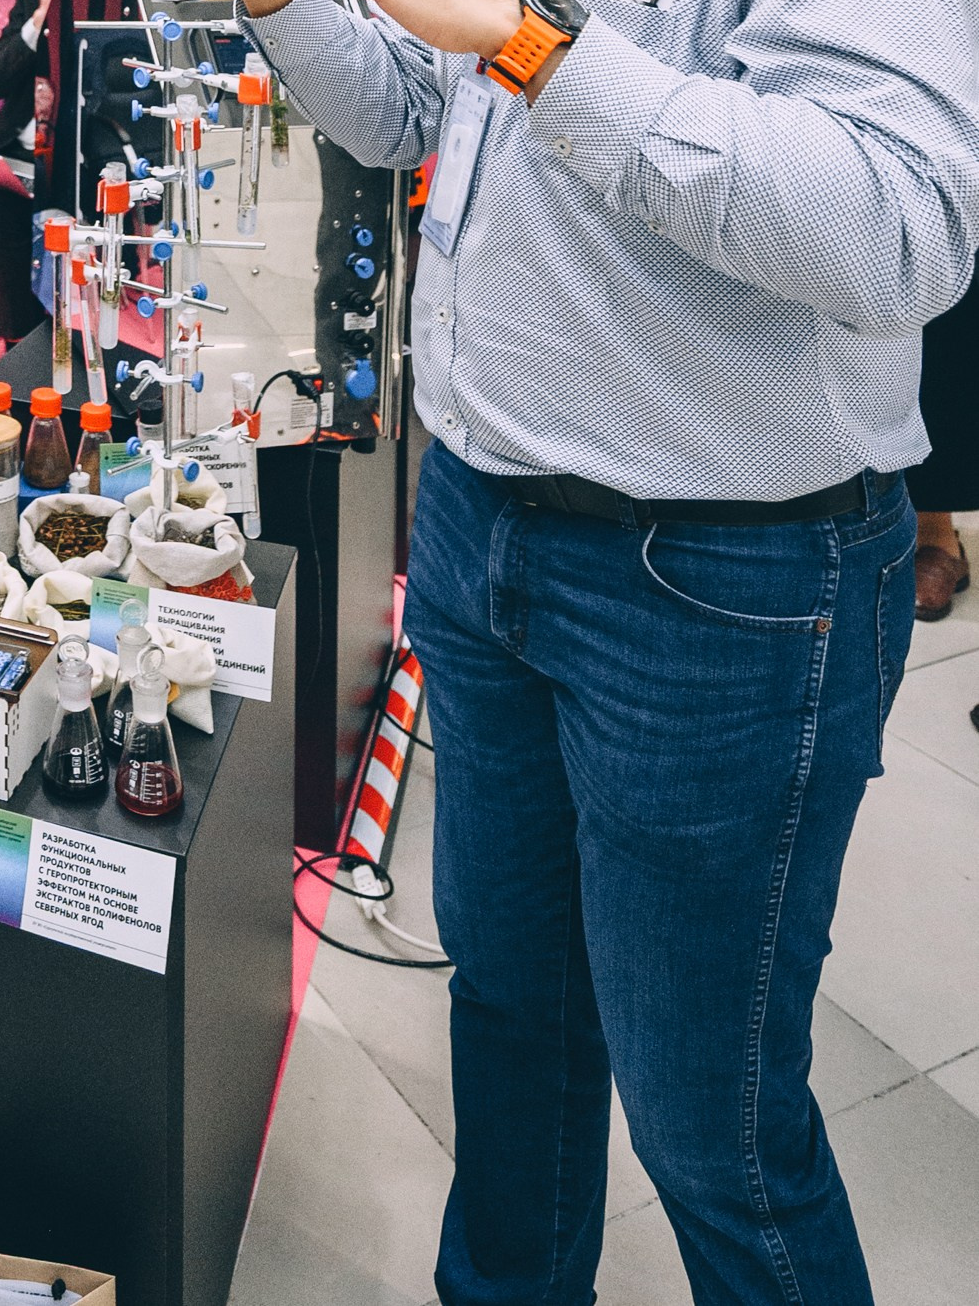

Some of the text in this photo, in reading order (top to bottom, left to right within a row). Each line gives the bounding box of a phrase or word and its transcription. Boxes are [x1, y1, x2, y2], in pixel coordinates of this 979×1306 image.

[157, 617, 226, 635] ВЫРАЩИВАНИЯ
[158, 605, 215, 622] ТЕХНОЛОГИИ
[42, 832, 97, 855] РАЗРАБОТКА
[40, 854, 92, 877] ПРОДУКТОВ
[41, 843, 127, 875] ФУНКЦИОНАЛЬНЫХ
[37, 878, 139, 915] ЭФФЕКТОМ НА ОСНОВЕ
[38, 866, 138, 902] С ГЕРОПРОТЕКТОРНЫМ
[34, 900, 105, 930] СЕВЕРНЫХ ЯГОД
[36, 889, 162, 934] ЭКСТРАКТОВ ПОЛИФЕНОЛОВ
